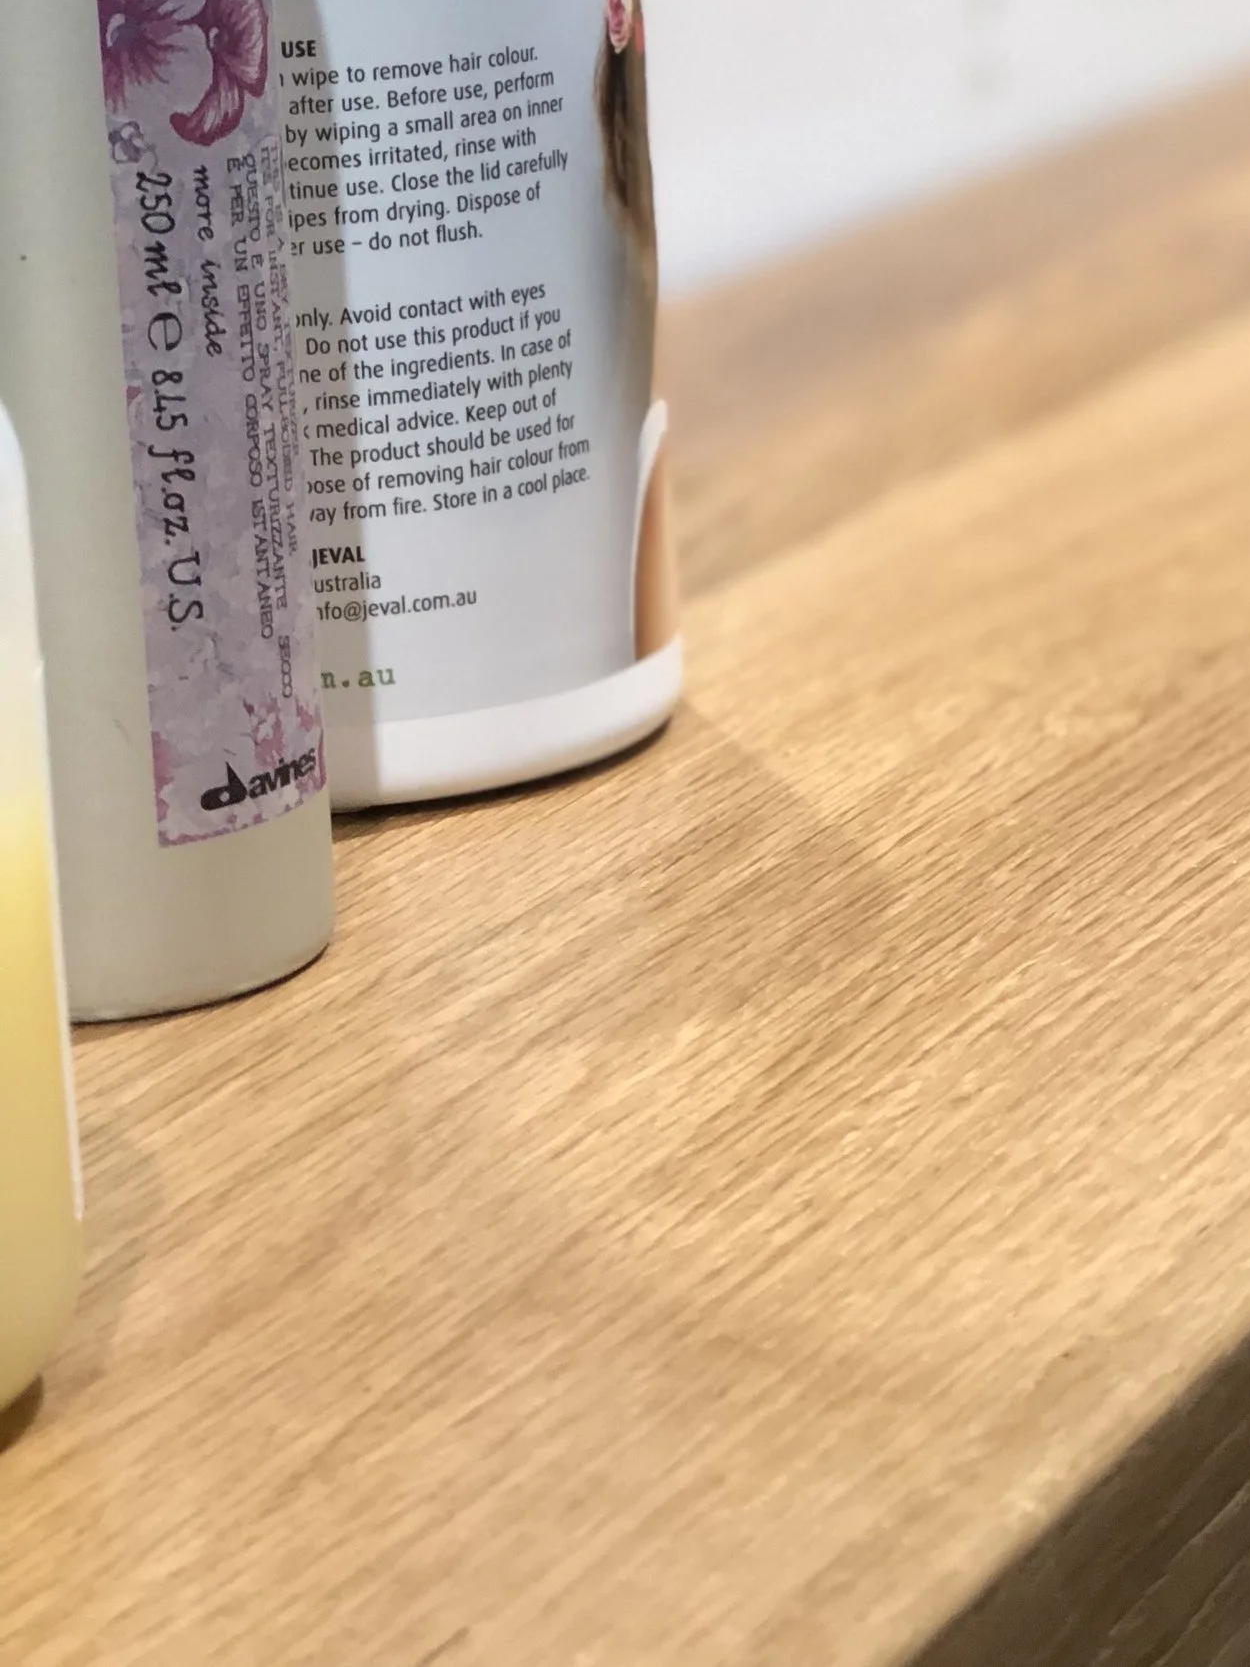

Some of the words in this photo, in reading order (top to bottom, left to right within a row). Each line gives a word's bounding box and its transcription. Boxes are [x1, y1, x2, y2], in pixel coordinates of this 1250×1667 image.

[281, 40, 316, 58] USE
[292, 68, 339, 90] wipe
[347, 67, 365, 82] to
[373, 61, 442, 82] remove
[449, 52, 482, 73] hair
[488, 46, 537, 67] colour.
[289, 95, 334, 115] after
[342, 96, 379, 112] use.
[387, 86, 447, 108] Before
[454, 84, 487, 101] use,
[494, 71, 554, 99] perform
[285, 125, 308, 147] by
[315, 122, 380, 144] wiping
[388, 122, 398, 136] a
[405, 111, 454, 134] small
[460, 110, 497, 128] area
[502, 106, 522, 122] on
[527, 97, 563, 117] inner
[369, 140, 448, 166] irritated,
[455, 137, 496, 156] rinse
[501, 127, 537, 149] with
[242, 153, 262, 242] QUESTO
[289, 182, 338, 199] tinue
[346, 180, 384, 196] use.
[391, 172, 439, 192] Close
[446, 166, 474, 186] the
[480, 160, 501, 182] lid
[506, 149, 568, 177] carefully
[136, 171, 176, 234] 250
[194, 165, 214, 242] more
[229, 184, 245, 226] PER
[265, 195, 276, 237] FOR
[288, 211, 327, 231] ipes
[334, 206, 379, 224] from
[386, 201, 450, 223] drying.
[457, 189, 521, 213] Dispose
[526, 181, 541, 201] of
[234, 237, 248, 272] UN
[313, 238, 345, 255] use
[368, 231, 392, 251] do
[399, 228, 429, 248] not
[436, 220, 483, 244] flush.
[144, 241, 182, 297] ml
[200, 259, 227, 357] inside
[254, 281, 267, 331] UNO
[340, 302, 392, 325] Avoid
[399, 298, 463, 320] contact
[468, 288, 506, 311] with
[511, 283, 546, 307] eyes
[237, 285, 256, 383] EFFETTO
[299, 368, 322, 383] ne
[328, 362, 347, 382] of
[353, 360, 385, 380] the
[391, 349, 495, 379] ingredients.
[501, 345, 516, 362] In
[521, 338, 553, 357] case
[558, 328, 571, 349] of
[306, 338, 330, 355] Do
[338, 335, 369, 353] not
[375, 333, 407, 350] use
[413, 326, 445, 345] this
[452, 318, 514, 346] product
[520, 311, 530, 330] if
[534, 308, 561, 332] you
[257, 342, 274, 413] SPRAY
[315, 392, 361, 410] rinse
[367, 376, 481, 406] immediately
[487, 368, 523, 391] with
[528, 359, 573, 388] plenty
[316, 414, 390, 438] medical
[396, 409, 459, 432] advice.
[466, 403, 507, 423] Keep
[512, 394, 537, 415] out
[542, 387, 556, 407] of
[245, 394, 263, 488] CORPOSO
[309, 448, 344, 466] The
[350, 442, 420, 469] product
[427, 430, 484, 456] should
[490, 428, 511, 447] be
[516, 417, 552, 441] used
[556, 413, 575, 433] for
[352, 472, 370, 492] of
[377, 465, 464, 490] removing
[470, 457, 502, 479] hair
[507, 447, 553, 471] colour
[558, 438, 590, 460] from
[343, 501, 386, 521] from
[392, 497, 427, 516] fire.
[433, 490, 477, 511] Store
[483, 486, 498, 503] in
[503, 486, 513, 500] a
[518, 473, 548, 497] cool
[552, 465, 591, 493] place.
[312, 546, 365, 569] JEVAL
[314, 571, 381, 593] ustralia
[200, 747, 317, 811] davines
